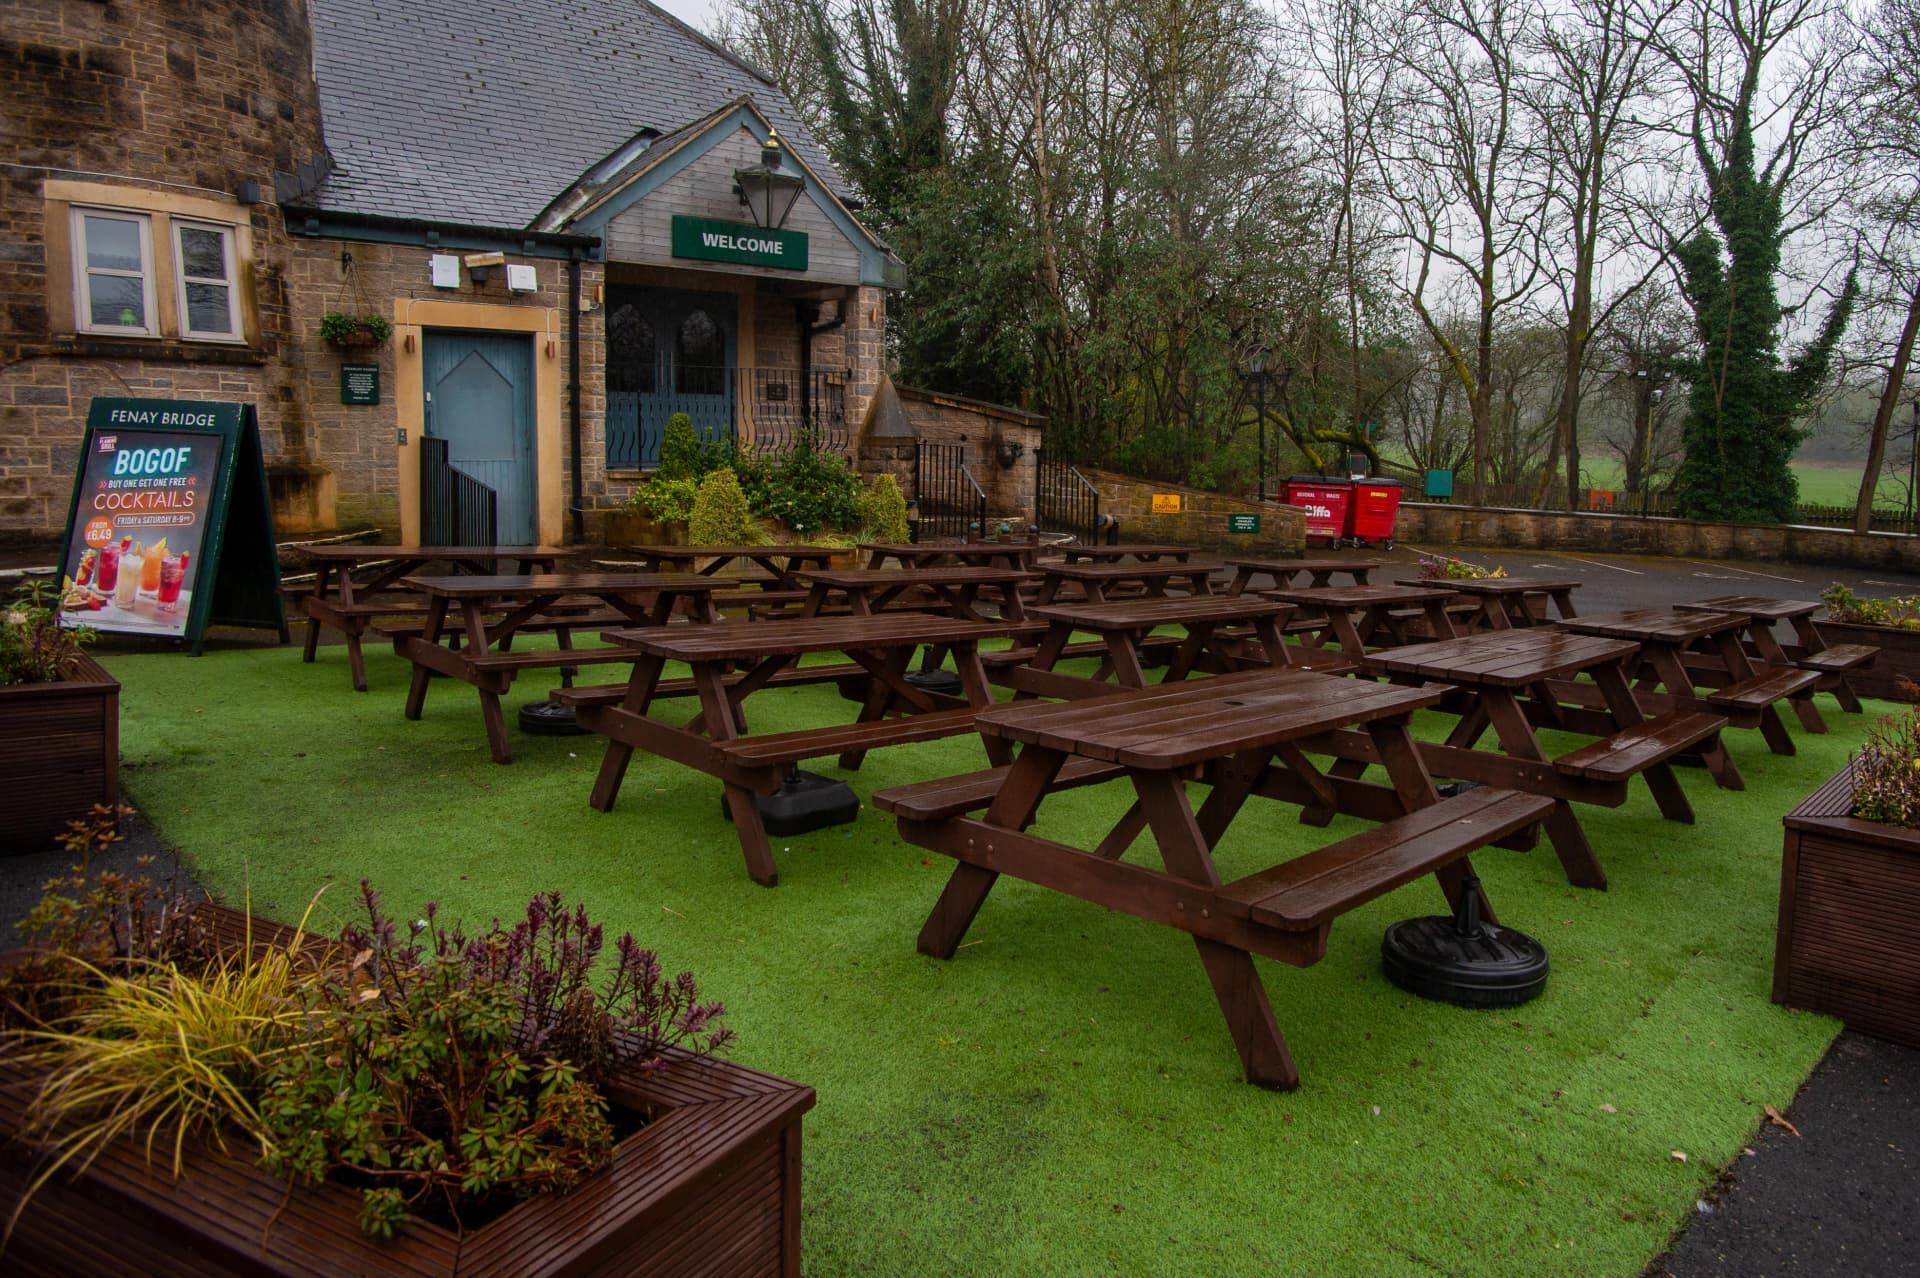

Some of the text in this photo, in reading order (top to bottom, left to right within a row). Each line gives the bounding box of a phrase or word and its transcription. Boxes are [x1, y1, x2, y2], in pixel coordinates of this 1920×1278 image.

[702, 232, 783, 255] WELCOME
[111, 409, 216, 427] FENAY BRIDGE
[113, 447, 192, 475] BOGOF
[108, 477, 187, 489] BUY ONE GET ONE FREE
[94, 490, 195, 510] COCKTAILS
[91, 521, 108, 529] FROM
[117, 516, 138, 525] FRIDAY
[142, 515, 172, 524] SATURDAY
[87, 529, 112, 541] £6.49
